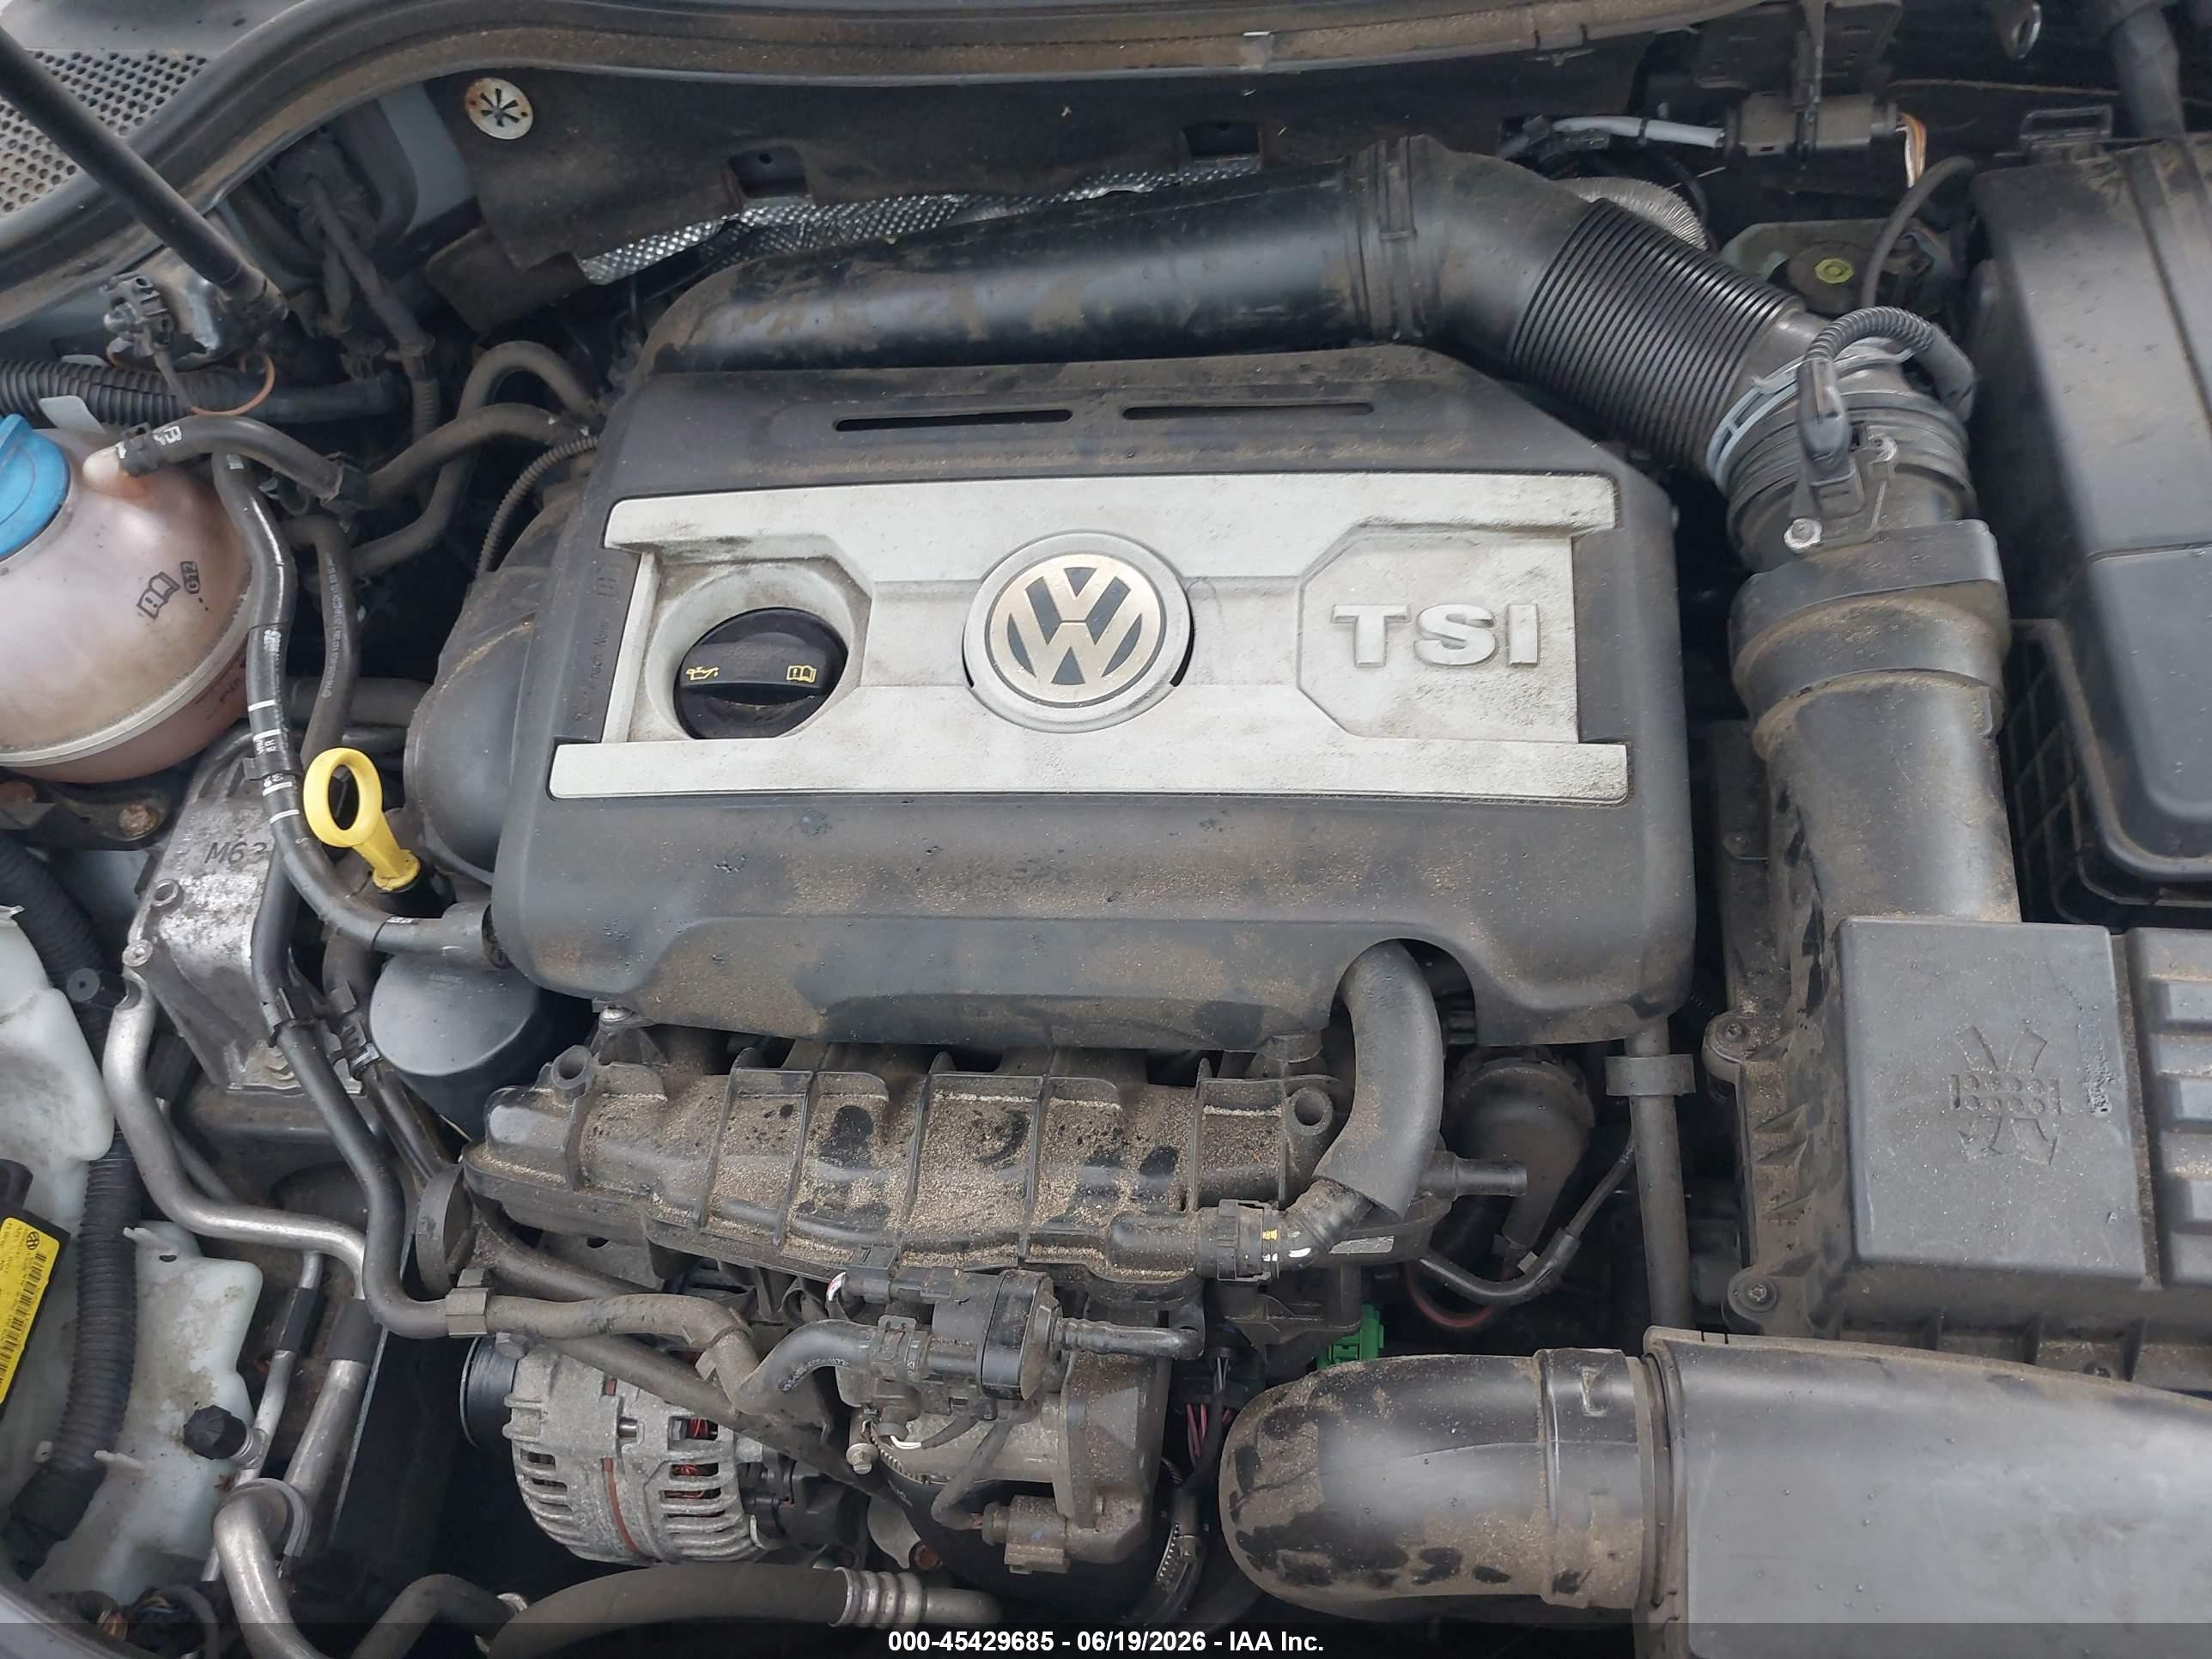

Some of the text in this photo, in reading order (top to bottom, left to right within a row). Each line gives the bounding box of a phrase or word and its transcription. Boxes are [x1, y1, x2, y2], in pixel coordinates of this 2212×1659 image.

[183, 562, 199, 591] G12
[990, 554, 1162, 703] VW
[1330, 603, 1540, 667] TSI
